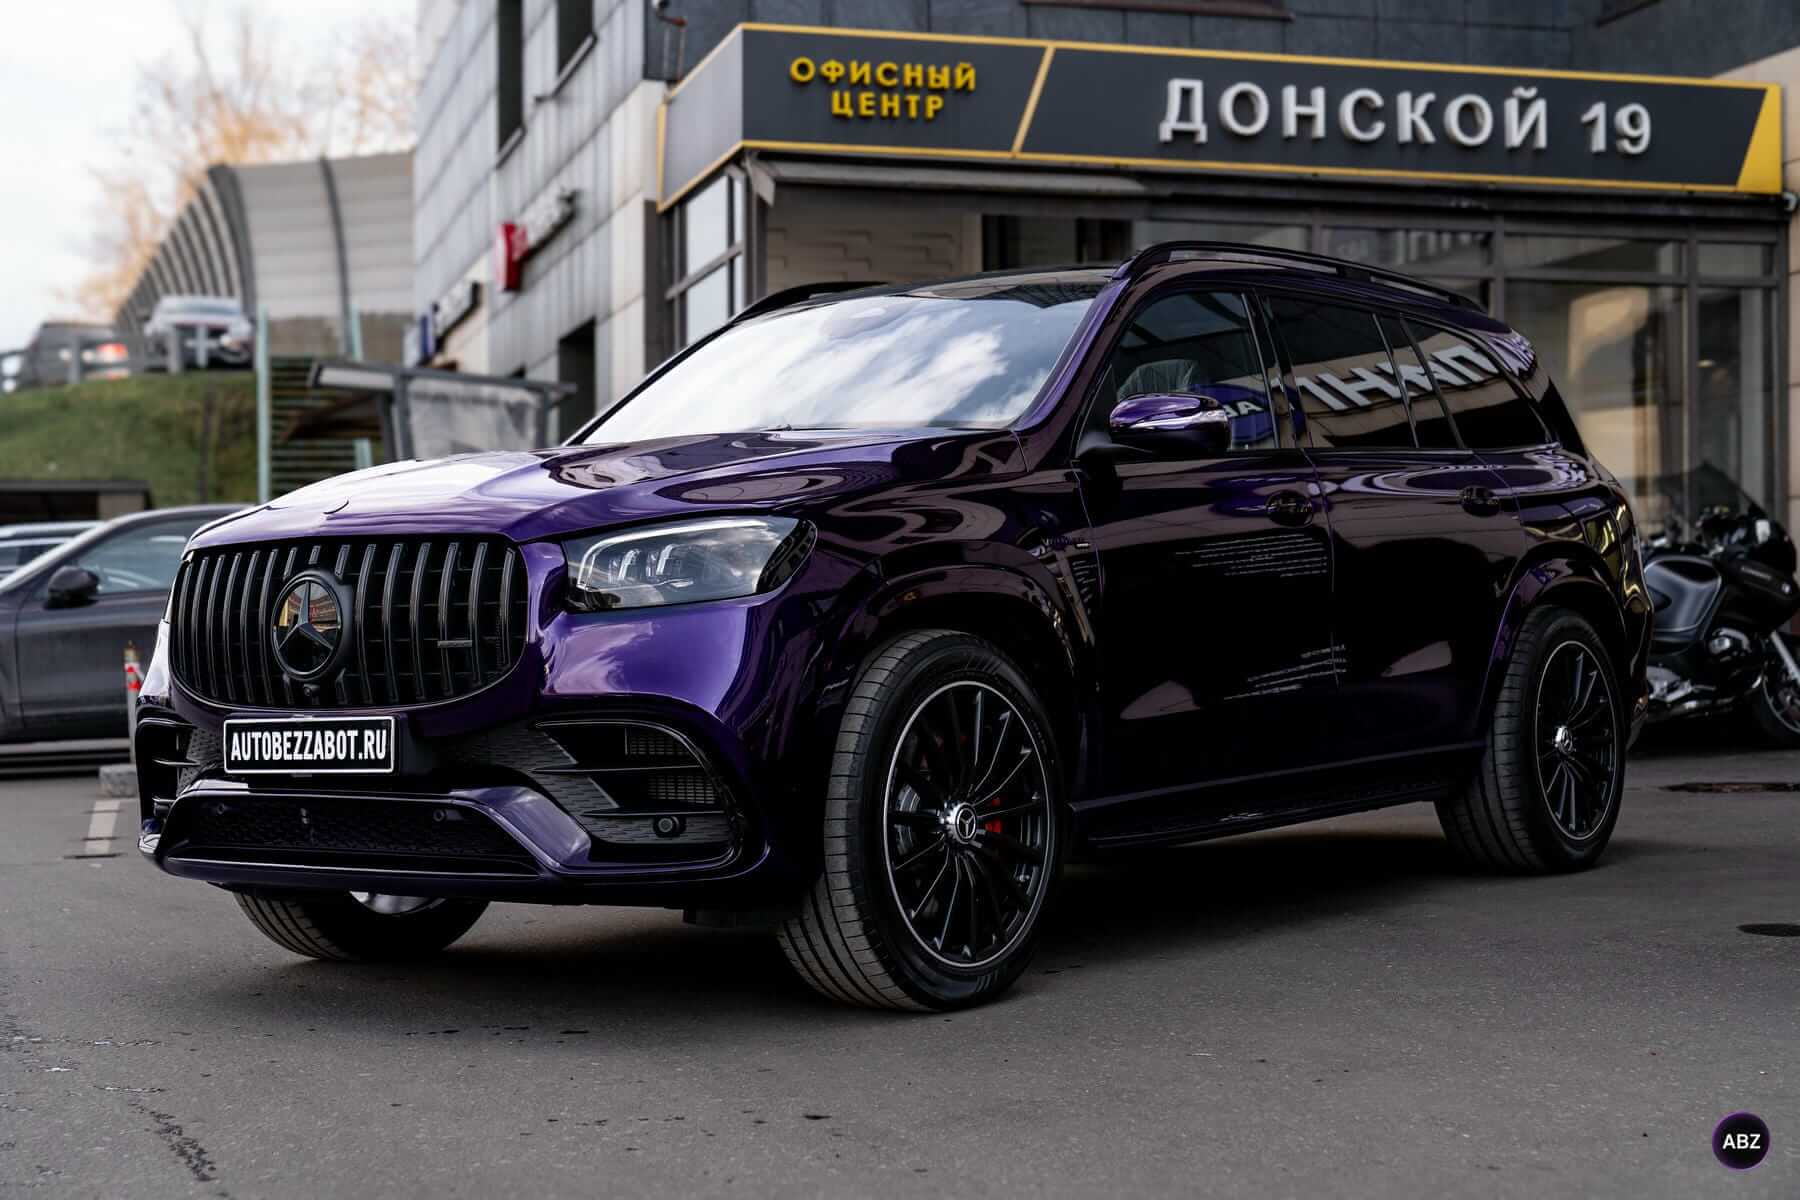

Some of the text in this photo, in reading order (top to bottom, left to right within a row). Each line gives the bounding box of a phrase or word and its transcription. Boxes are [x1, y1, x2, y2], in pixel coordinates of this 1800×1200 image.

[789, 56, 977, 92] ОФИСНЫЙ
[831, 90, 945, 119] ЦЕНТР
[1158, 78, 1652, 154] ДОНСКОЙ 19
[230, 729, 388, 761] AUTOBEZZABOT.RU
